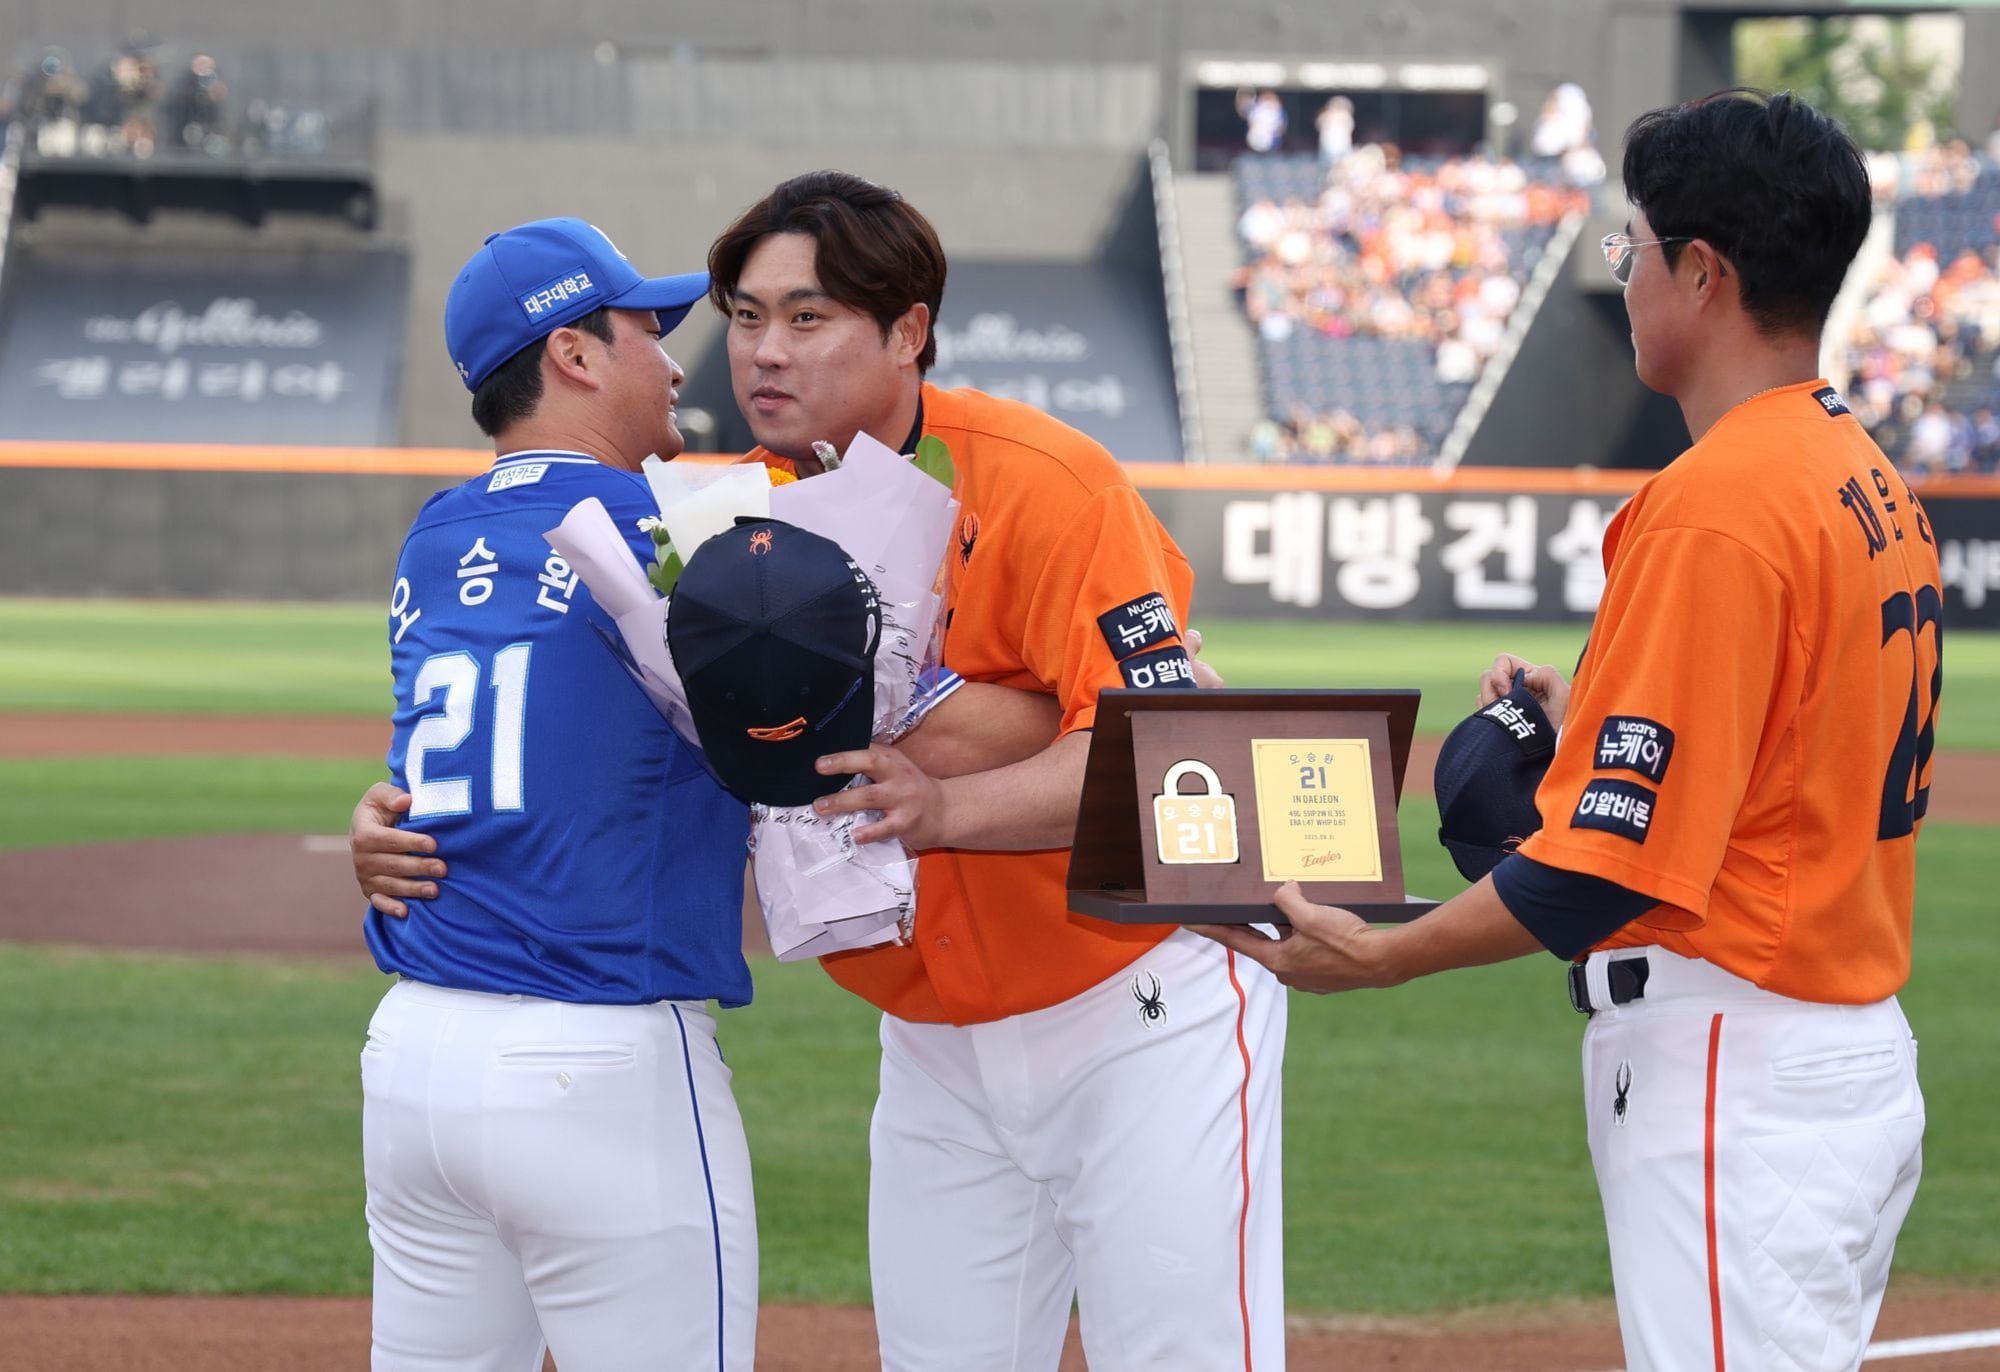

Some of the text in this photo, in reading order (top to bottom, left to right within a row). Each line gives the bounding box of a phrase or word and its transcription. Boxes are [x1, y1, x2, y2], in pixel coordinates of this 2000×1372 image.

[523, 273, 593, 314] 대구대학교
[492, 466, 542, 489] 삼성카드
[1155, 657, 1196, 684] 알바
[405, 641, 533, 820] 21
[1617, 721, 1657, 738] Nucare
[1600, 734, 1664, 775] 뉴케어
[1300, 766, 1326, 789] 21
[1303, 795, 1339, 803] DAEJEON
[1594, 791, 1650, 829] 알바몬
[1178, 822, 1217, 854] 21
[1301, 850, 1342, 868] Eagles
